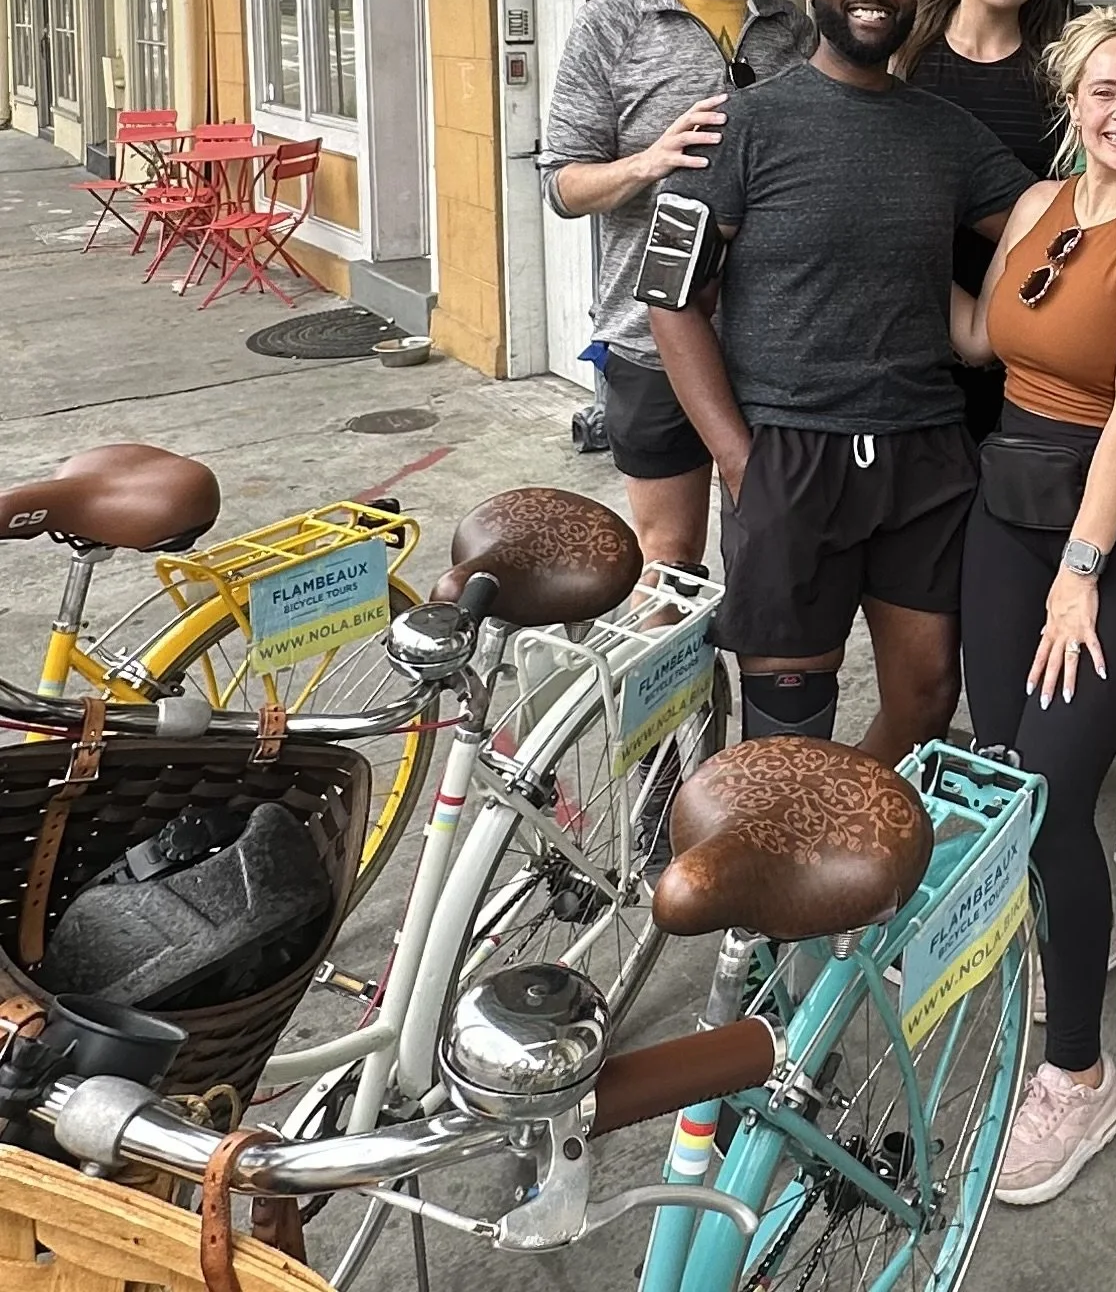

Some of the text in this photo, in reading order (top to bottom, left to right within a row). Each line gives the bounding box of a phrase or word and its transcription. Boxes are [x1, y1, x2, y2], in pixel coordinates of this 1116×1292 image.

[8, 509, 48, 529] C9
[272, 562, 369, 605] FLAMBEAUX
[283, 582, 358, 614] BICYCLE TOURS
[258, 606, 384, 660] WWW.NOLA.BIKE
[929, 840, 1018, 954] FLAMBEAUX
[938, 909, 980, 959] BICYCLE
[907, 891, 1027, 1035] WWW.NOLA.BIKE
